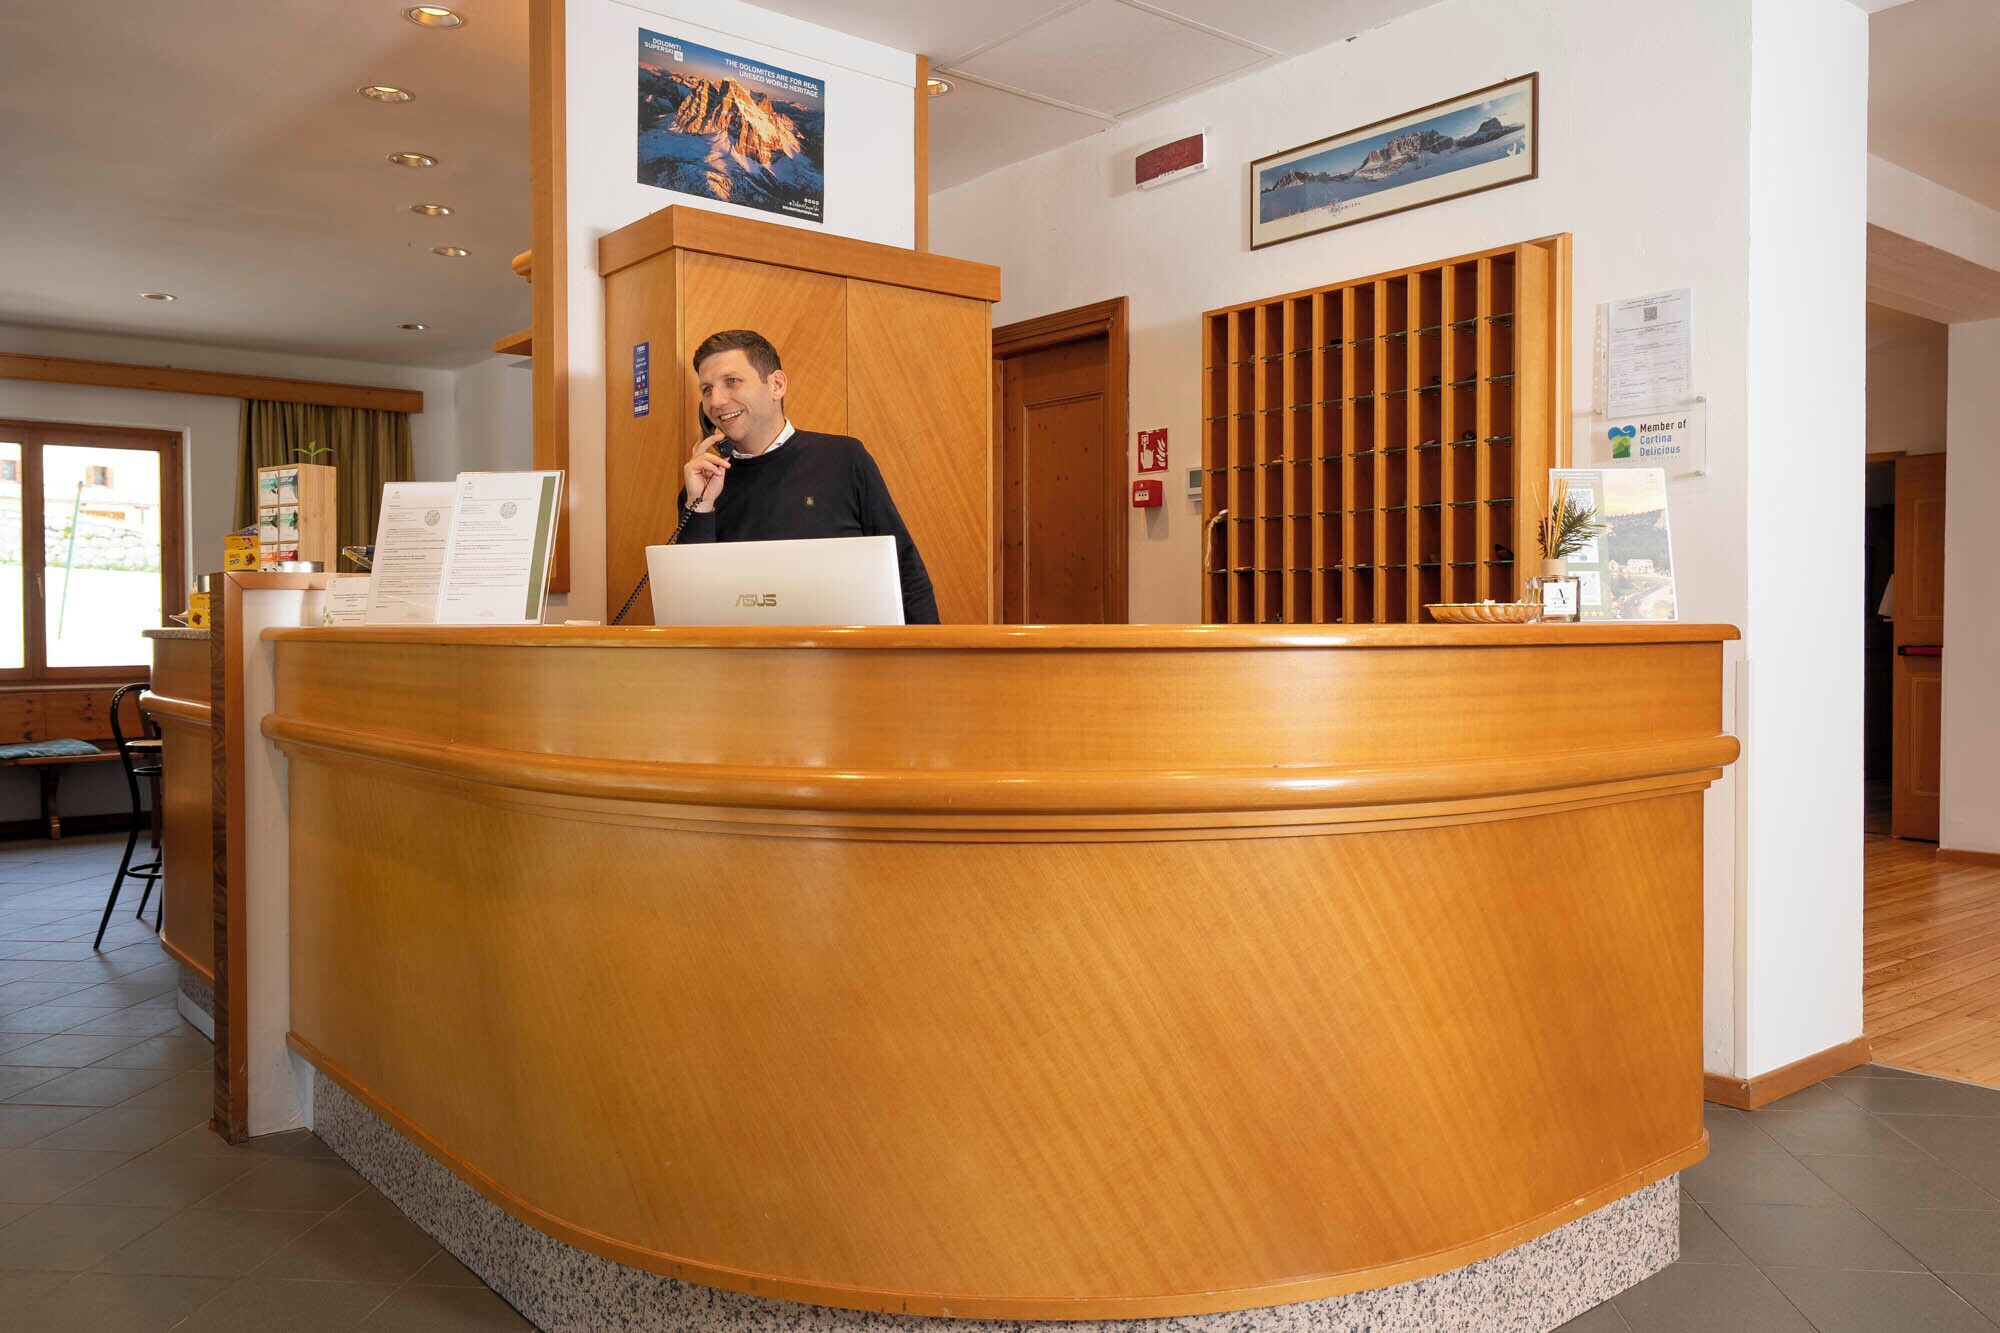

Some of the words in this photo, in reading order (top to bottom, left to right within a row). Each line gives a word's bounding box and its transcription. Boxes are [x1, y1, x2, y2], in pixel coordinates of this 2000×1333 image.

[644, 41, 674, 54] SUPERSKI
[652, 38, 682, 51] DOLOMITI
[725, 59, 738, 68] THE
[739, 62, 775, 79] DOLOMITES
[775, 73, 789, 82] ARE
[790, 77, 802, 86] FOR
[803, 81, 819, 91] REAL
[739, 70, 765, 83] UNESCO
[765, 77, 788, 89] WORLD
[789, 84, 819, 98] HERITAGE
[1640, 421, 1675, 433] Member
[1677, 419, 1687, 429] of
[1639, 434, 1672, 444] Cortina
[1639, 445, 1681, 456] Delicious
[735, 594, 777, 607] ASUS
